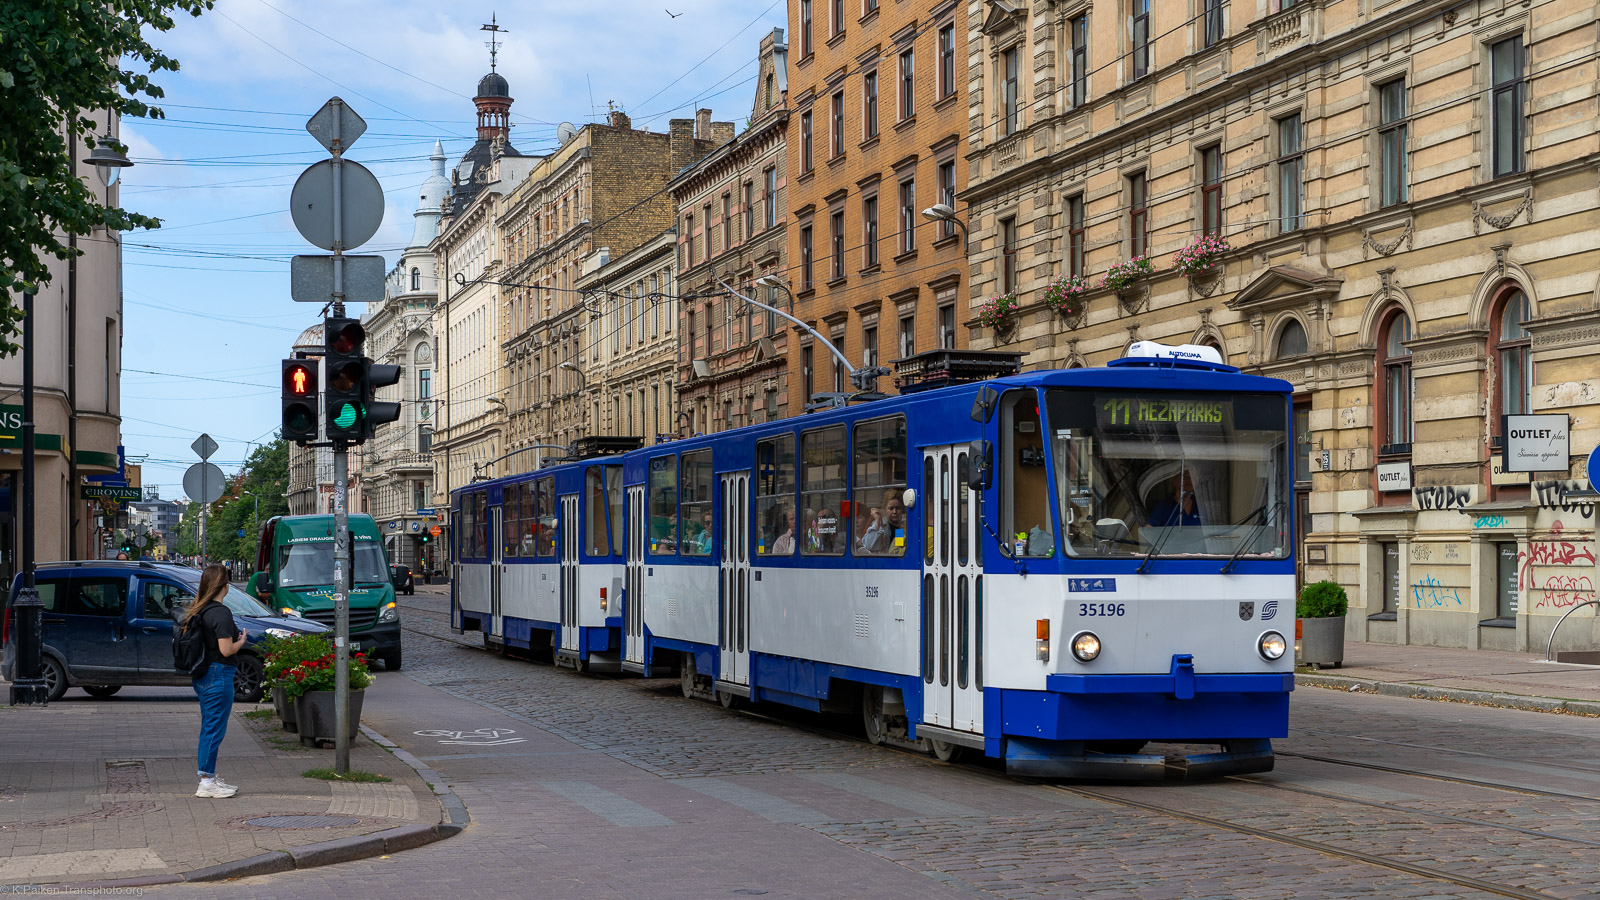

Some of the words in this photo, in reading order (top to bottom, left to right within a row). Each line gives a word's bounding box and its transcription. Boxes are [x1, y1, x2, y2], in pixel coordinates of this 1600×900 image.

[1103, 399, 1130, 425] 11
[1510, 429, 1551, 439] OUTLET
[1549, 430, 1566, 447] plus
[1379, 472, 1401, 482] OUTLET
[85, 488, 140, 497] EIROVINS
[865, 586, 879, 598] 35196
[1079, 603, 1125, 617] 35196
